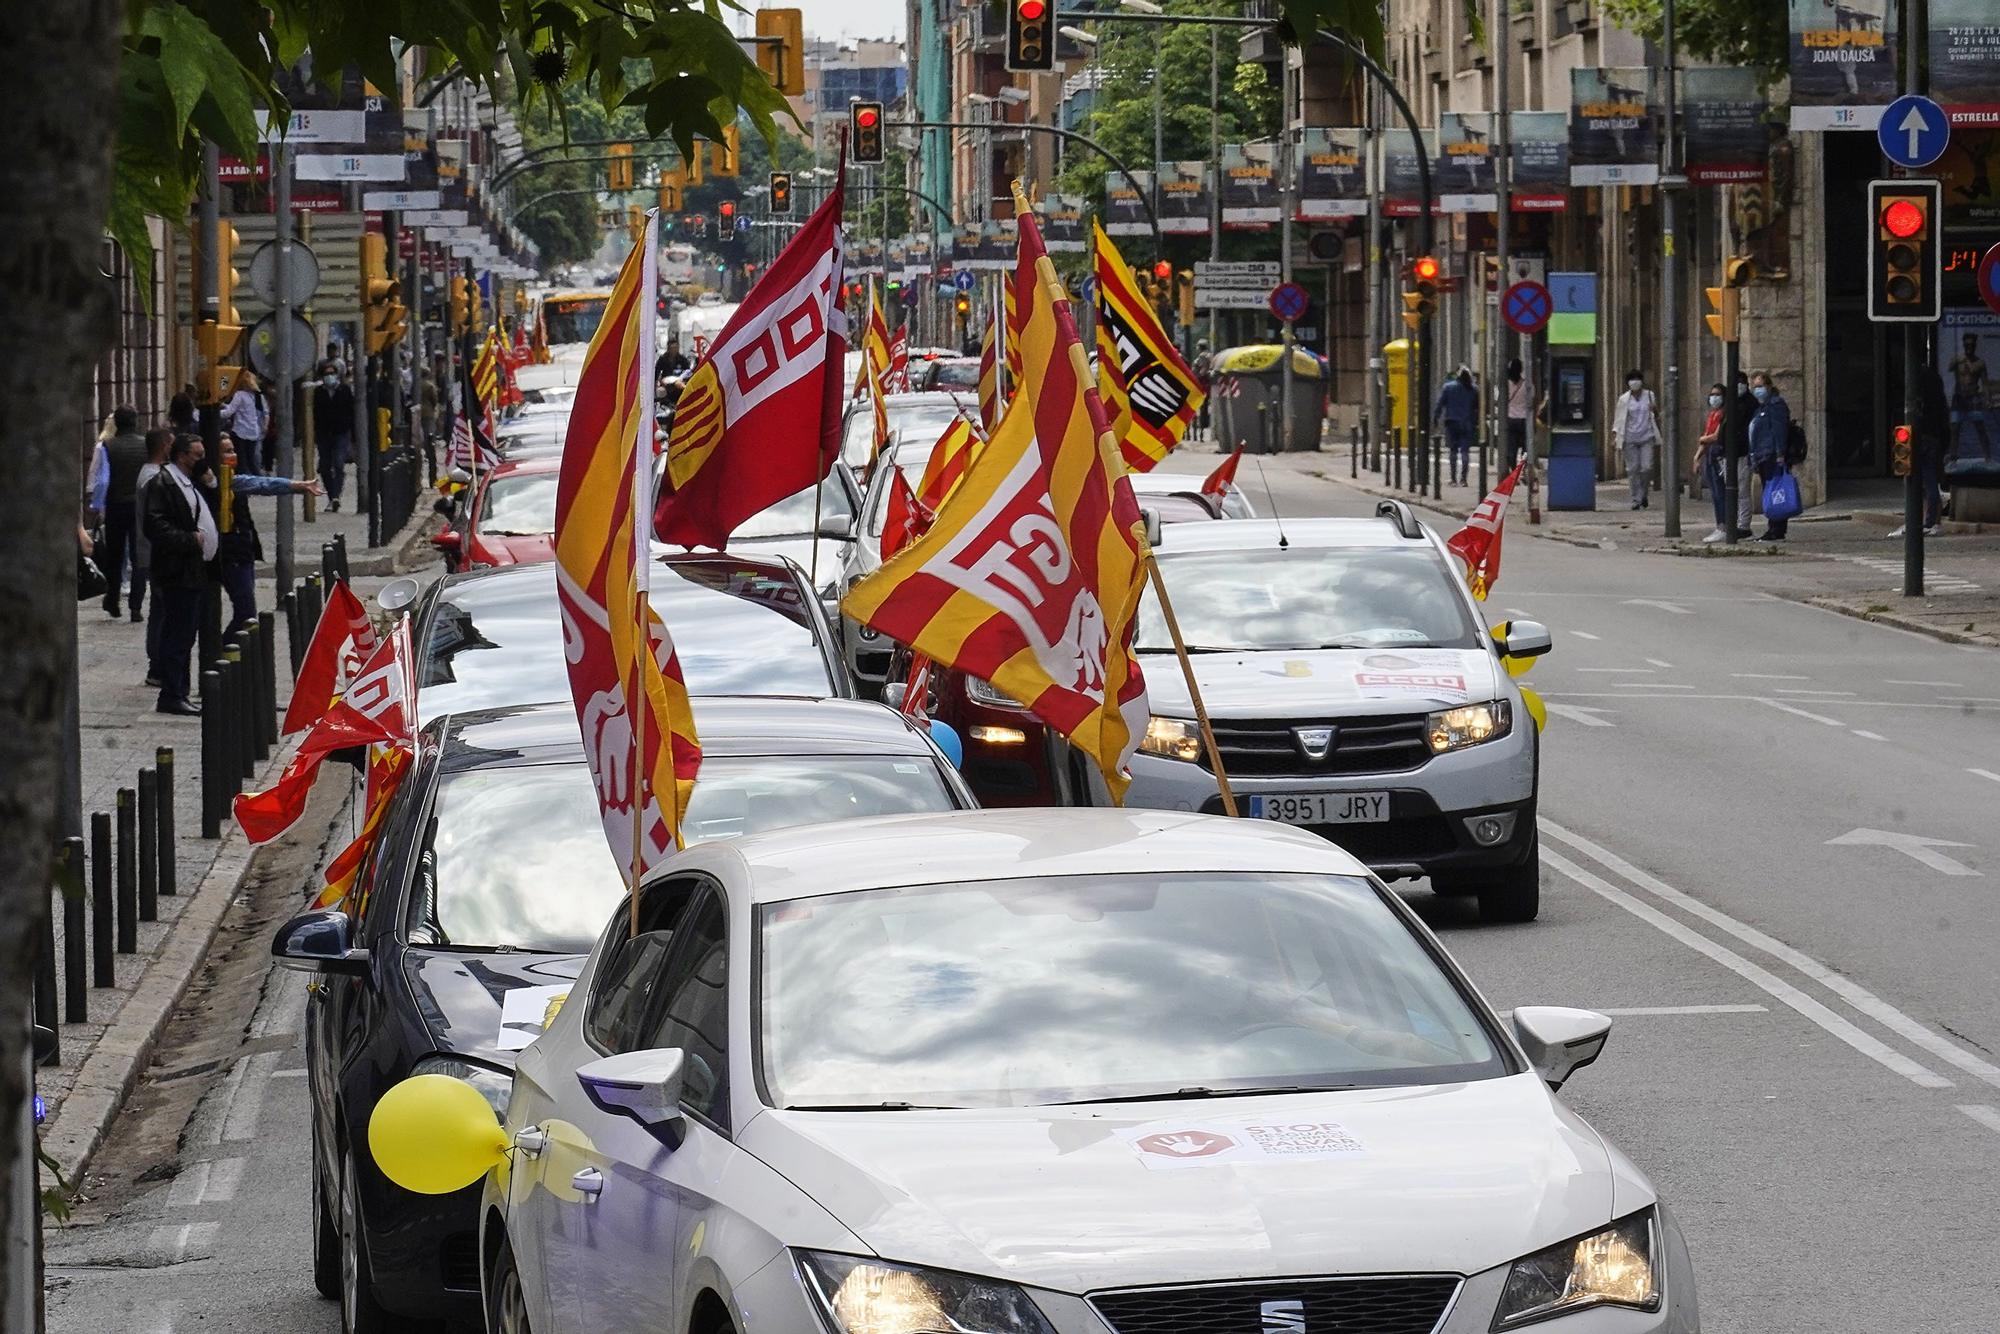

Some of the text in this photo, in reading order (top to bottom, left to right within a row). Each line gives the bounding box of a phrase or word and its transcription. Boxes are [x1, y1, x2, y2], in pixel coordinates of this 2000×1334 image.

[1813, 50, 1838, 62] JOAN
[1952, 112, 1999, 123] ESTRELLA
[1268, 797, 1384, 820] 3951 JRY
[1245, 1123, 1341, 1134] STOP
[1259, 1138, 1355, 1147] SALVAR
